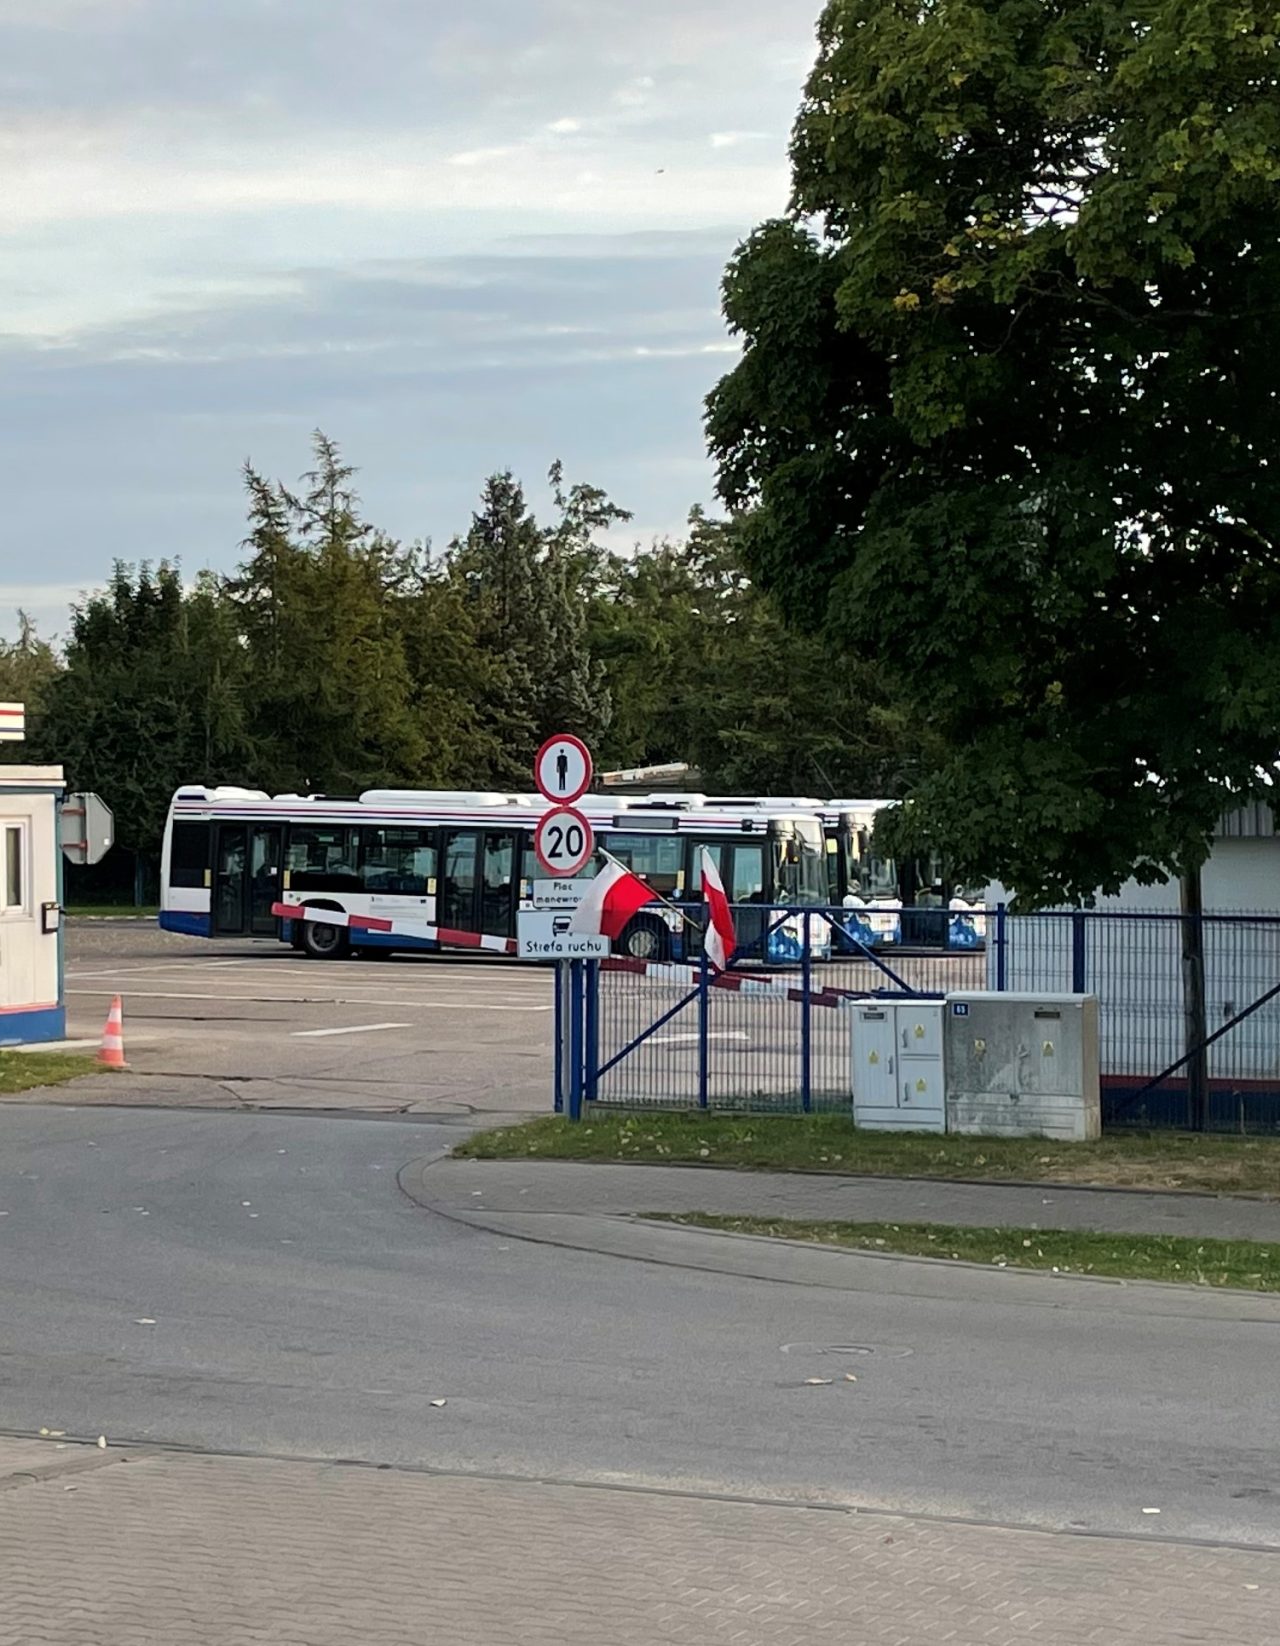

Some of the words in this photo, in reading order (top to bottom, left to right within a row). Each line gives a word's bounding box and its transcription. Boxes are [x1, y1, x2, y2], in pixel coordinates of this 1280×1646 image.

[548, 825, 583, 858] 20
[553, 882, 573, 891] Plac
[536, 896, 582, 904] manewro
[526, 941, 563, 953] Strefa
[568, 941, 601, 952] ruchu
